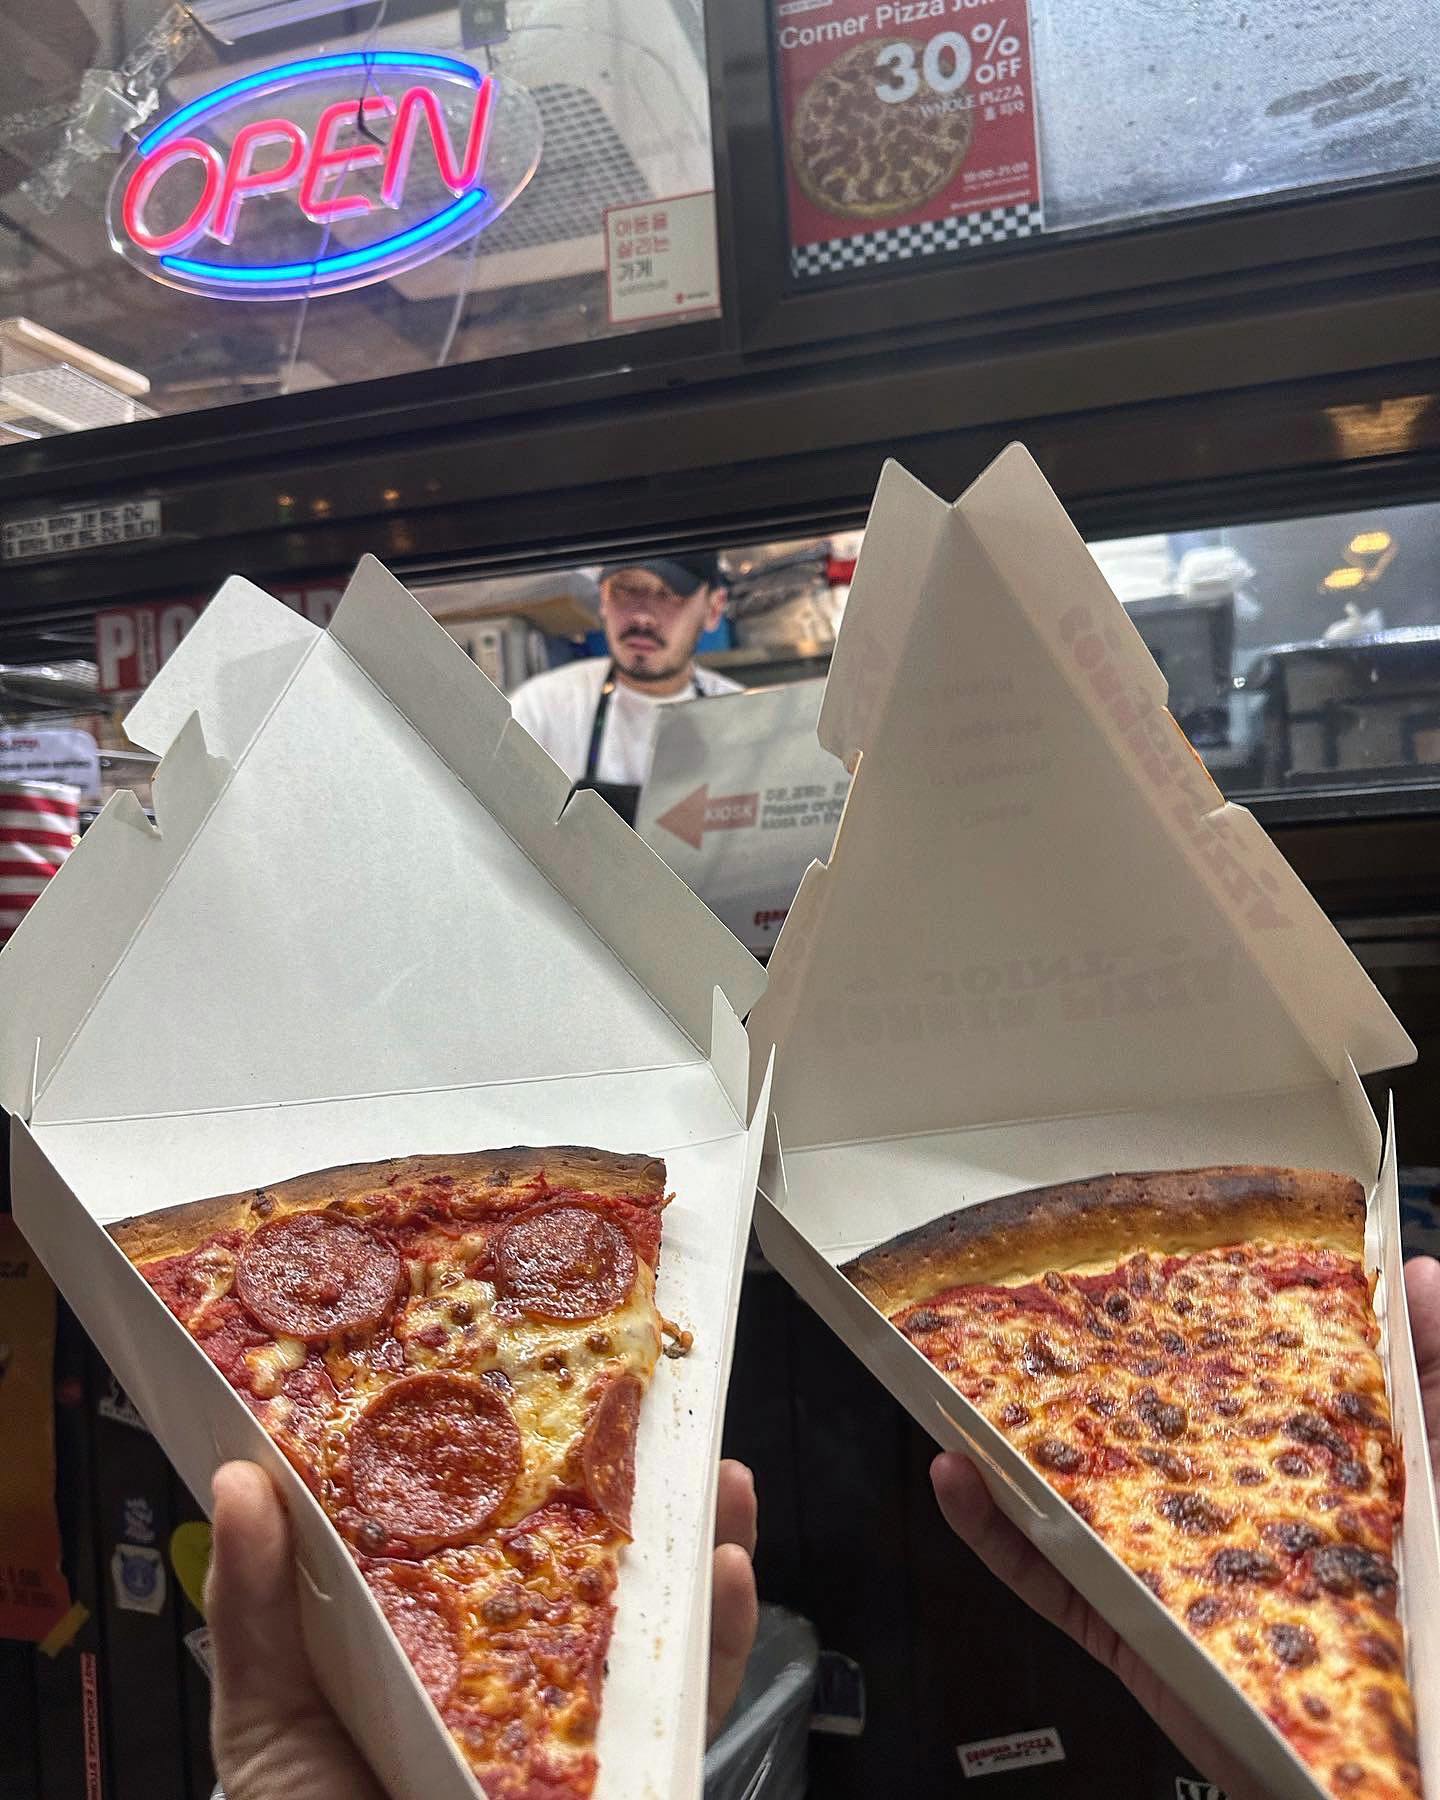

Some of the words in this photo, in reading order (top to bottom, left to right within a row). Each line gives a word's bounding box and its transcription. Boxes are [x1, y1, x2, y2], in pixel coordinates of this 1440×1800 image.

[779, 14, 868, 49] Corner
[875, 0, 945, 29] Pizza
[974, 57, 1022, 84] OFF
[918, 94, 977, 119] WHOLE
[979, 84, 1024, 106] PIZZA
[122, 75, 498, 257] OPEN
[617, 258, 654, 281] 가게
[703, 803, 752, 822] KIOSK
[800, 813, 820, 827] on
